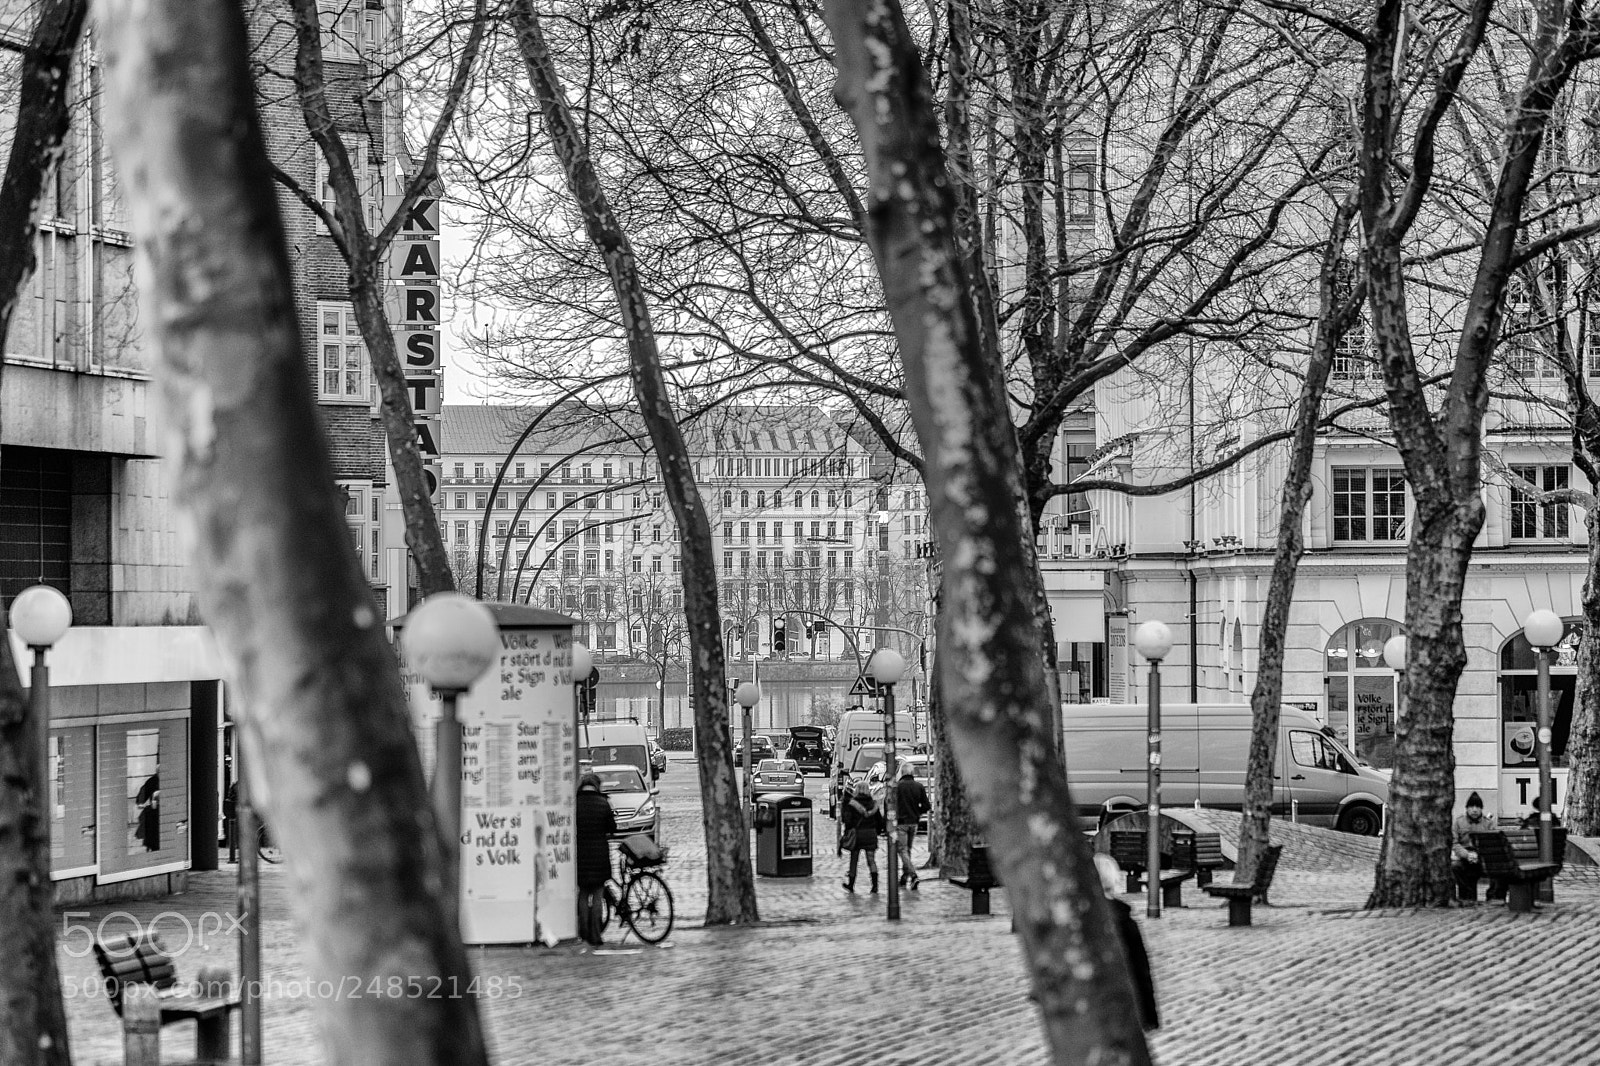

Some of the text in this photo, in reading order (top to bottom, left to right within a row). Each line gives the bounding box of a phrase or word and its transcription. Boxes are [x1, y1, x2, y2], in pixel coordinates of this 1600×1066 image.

[402, 199, 438, 499] KARSTAD
[501, 685, 522, 701] ale
[1357, 693, 1382, 703] Völke
[1367, 713, 1387, 726] Sign
[1357, 723, 1371, 733] ale
[475, 813, 508, 829] Wer
[475, 831, 519, 847] nd da
[487, 849, 521, 866] Volk
